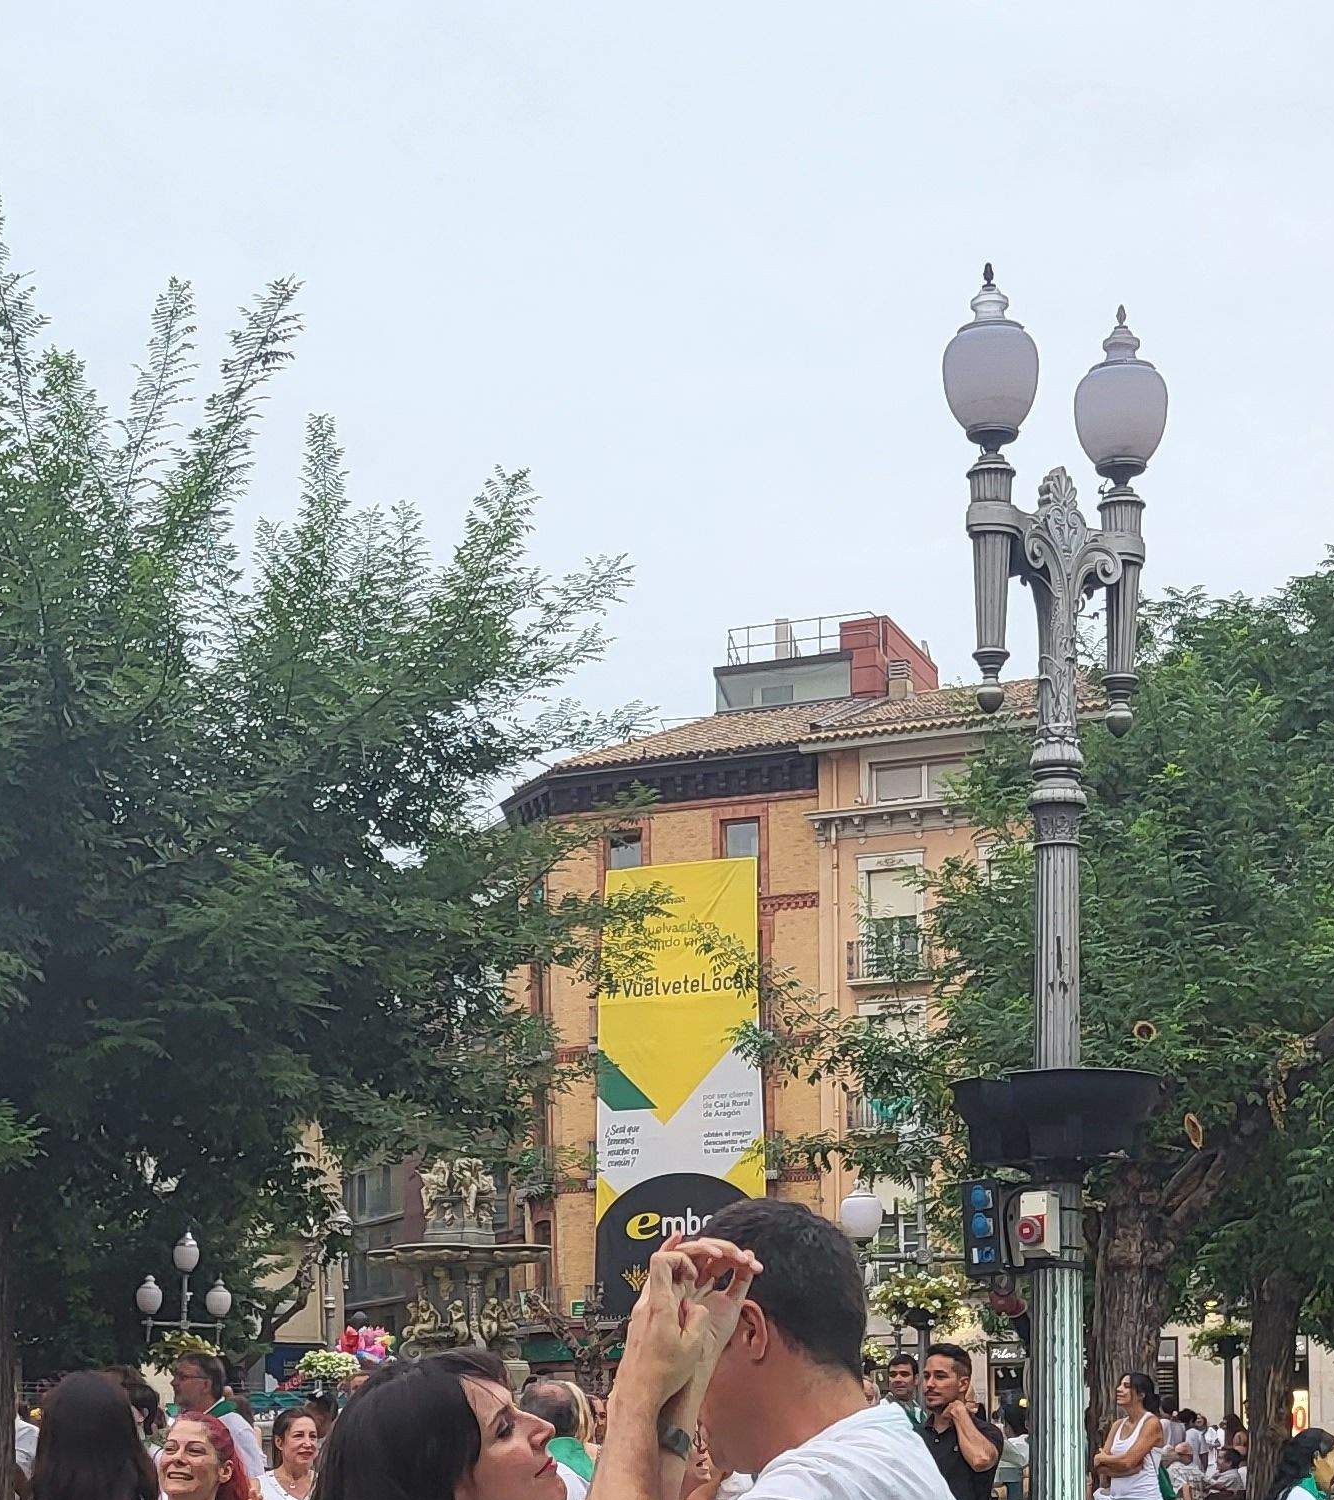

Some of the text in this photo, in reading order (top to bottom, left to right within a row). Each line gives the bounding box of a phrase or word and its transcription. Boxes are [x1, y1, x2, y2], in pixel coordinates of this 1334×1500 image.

[729, 1091, 754, 1099] cliente
[703, 1099, 750, 1110] de Caja Rural
[703, 1109, 741, 1119] de Aragón
[627, 1126, 640, 1136] que
